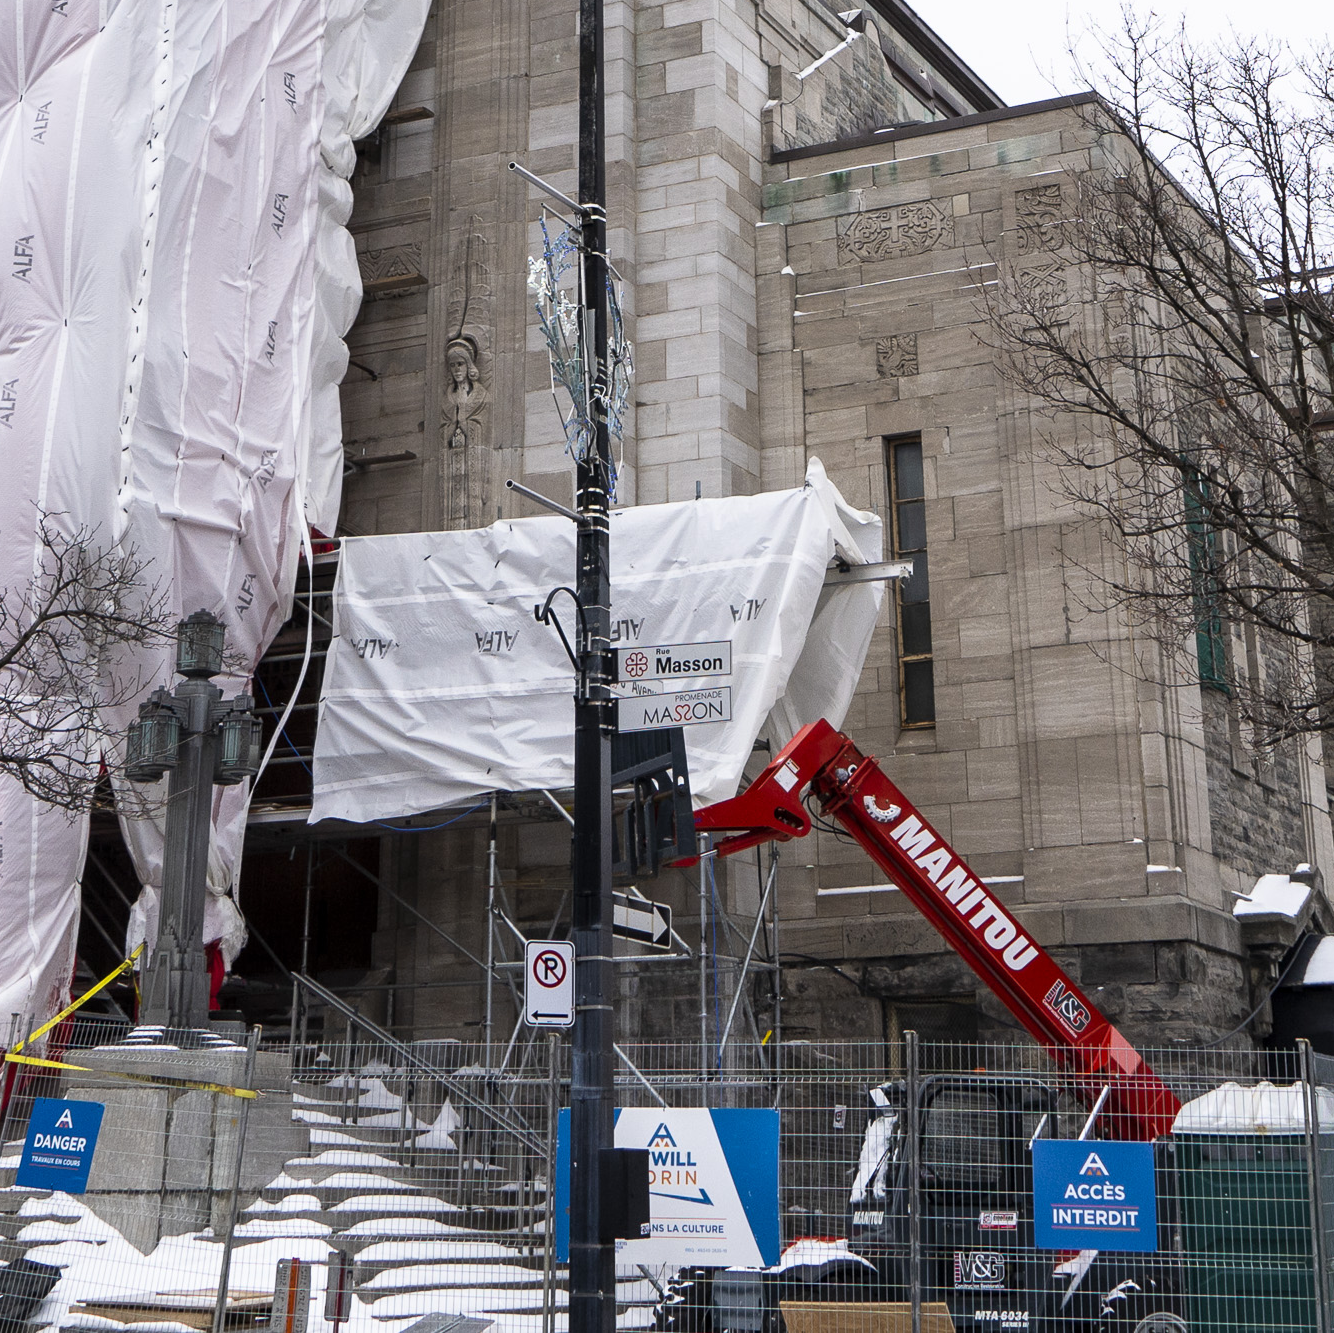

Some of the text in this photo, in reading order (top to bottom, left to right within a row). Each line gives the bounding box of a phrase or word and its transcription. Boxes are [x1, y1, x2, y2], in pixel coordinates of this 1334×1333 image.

[285, 71, 296, 115] ALFA
[30, 100, 52, 145] ALFA
[271, 193, 289, 239] ALFA
[11, 234, 35, 284] ALFA
[234, 573, 257, 621] ALFA
[610, 617, 645, 642] ALF
[475, 629, 520, 653] ALFA
[655, 656, 723, 674] Masson
[632, 681, 657, 696] Aven
[675, 690, 722, 702] PROMENADE
[643, 700, 723, 725] MASSON
[889, 814, 1039, 971] MANITOU
[33, 1133, 87, 1152] DANGER
[31, 1155, 54, 1164] TRAVAUX
[63, 1158, 80, 1167] COURS
[649, 1151, 697, 1167] WILL
[649, 1170, 697, 1185] ORIN
[1064, 1180, 1125, 1201] ACCÈS
[852, 1211, 885, 1225] MANITOU
[1052, 1208, 1139, 1226] INTERDIT
[667, 1224, 679, 1233] LA
[682, 1224, 724, 1234] CULTURE
[975, 1310, 1029, 1321] MTA 6034
